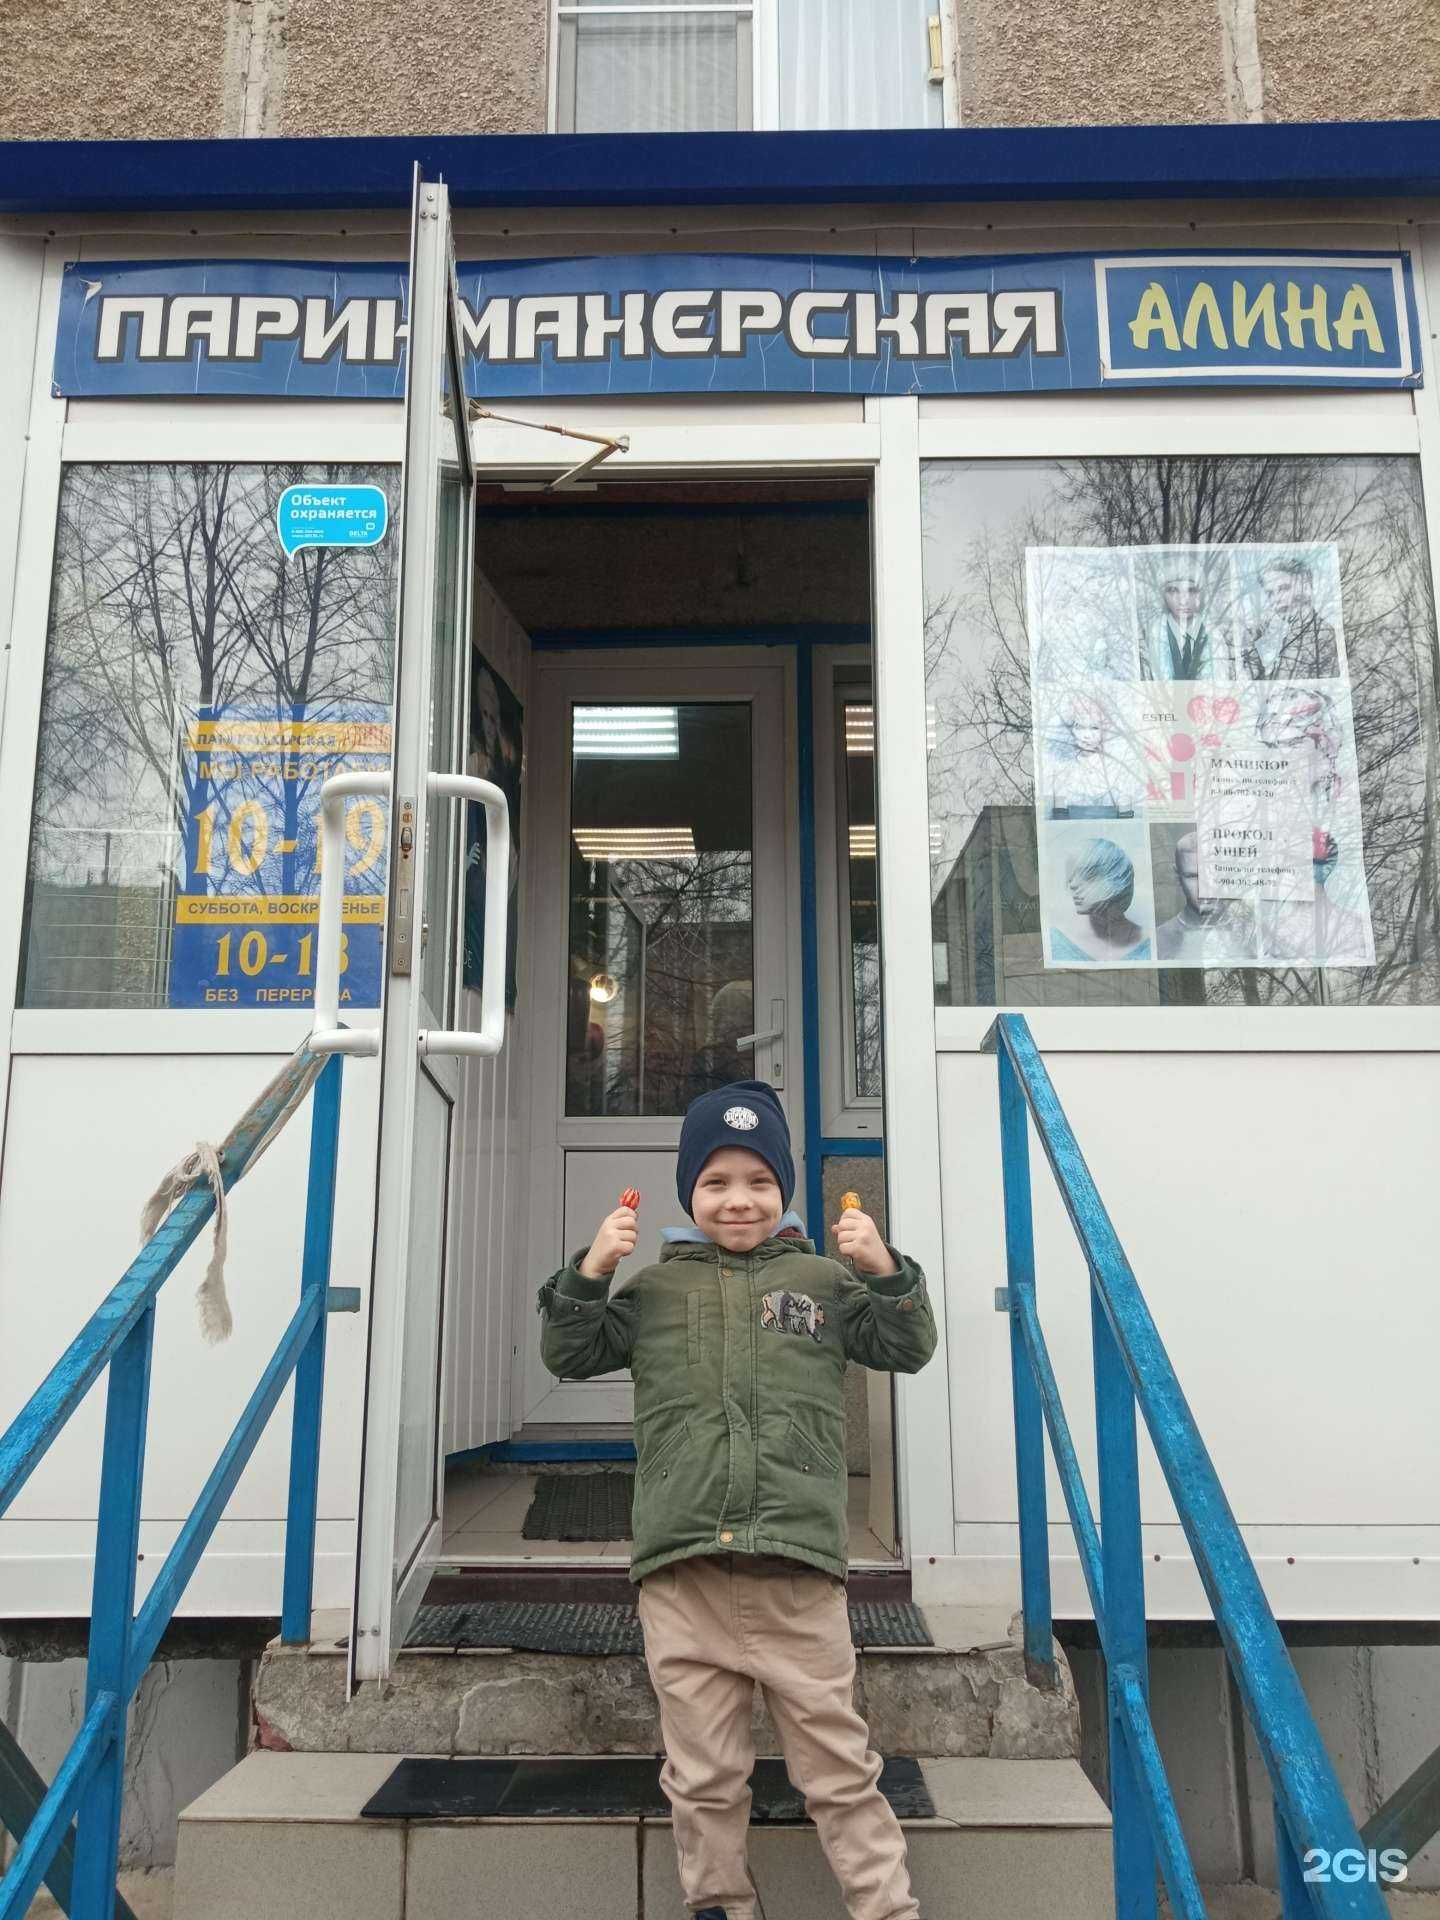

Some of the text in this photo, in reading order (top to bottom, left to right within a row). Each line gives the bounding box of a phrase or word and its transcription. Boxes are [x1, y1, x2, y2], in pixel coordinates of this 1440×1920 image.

[1128, 281, 1385, 353] АЛИНА
[291, 494, 347, 506] Объект
[290, 509, 377, 520] охраняется
[1142, 713, 1178, 721] ESTEL
[1214, 845, 1257, 858] УШЕЙ
[188, 903, 380, 915] СУББОТА, ВОСКРЕНЬЕ
[205, 989, 352, 1002] БЕЗ ПЕРЕРА
